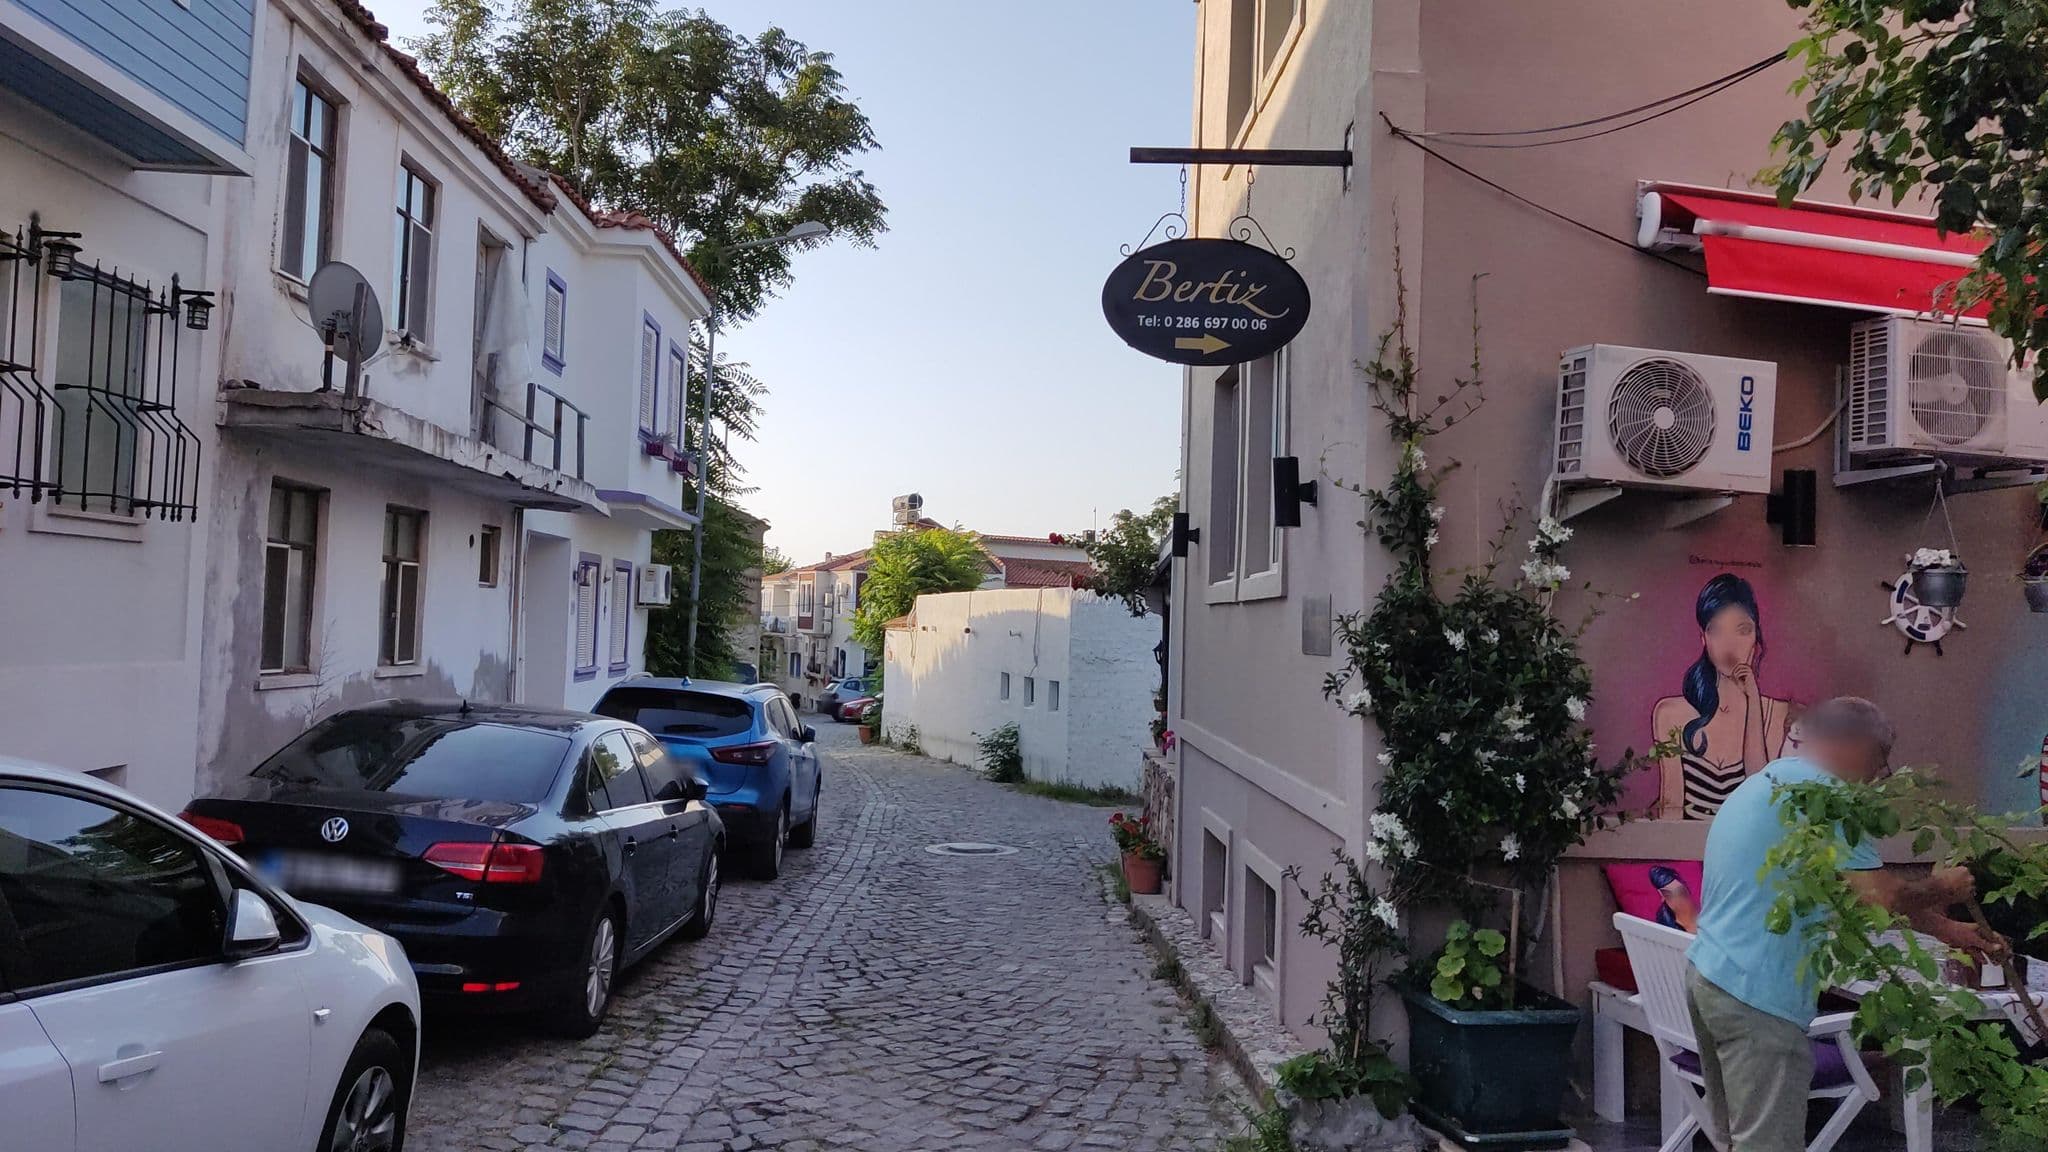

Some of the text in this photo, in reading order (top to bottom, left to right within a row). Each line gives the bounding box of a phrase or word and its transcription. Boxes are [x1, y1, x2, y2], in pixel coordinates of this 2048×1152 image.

[1133, 260, 1290, 319] Bertiz
[1137, 315, 1268, 330] Tel: 0 286 697 00 06
[1737, 376, 1754, 451] BEKO
